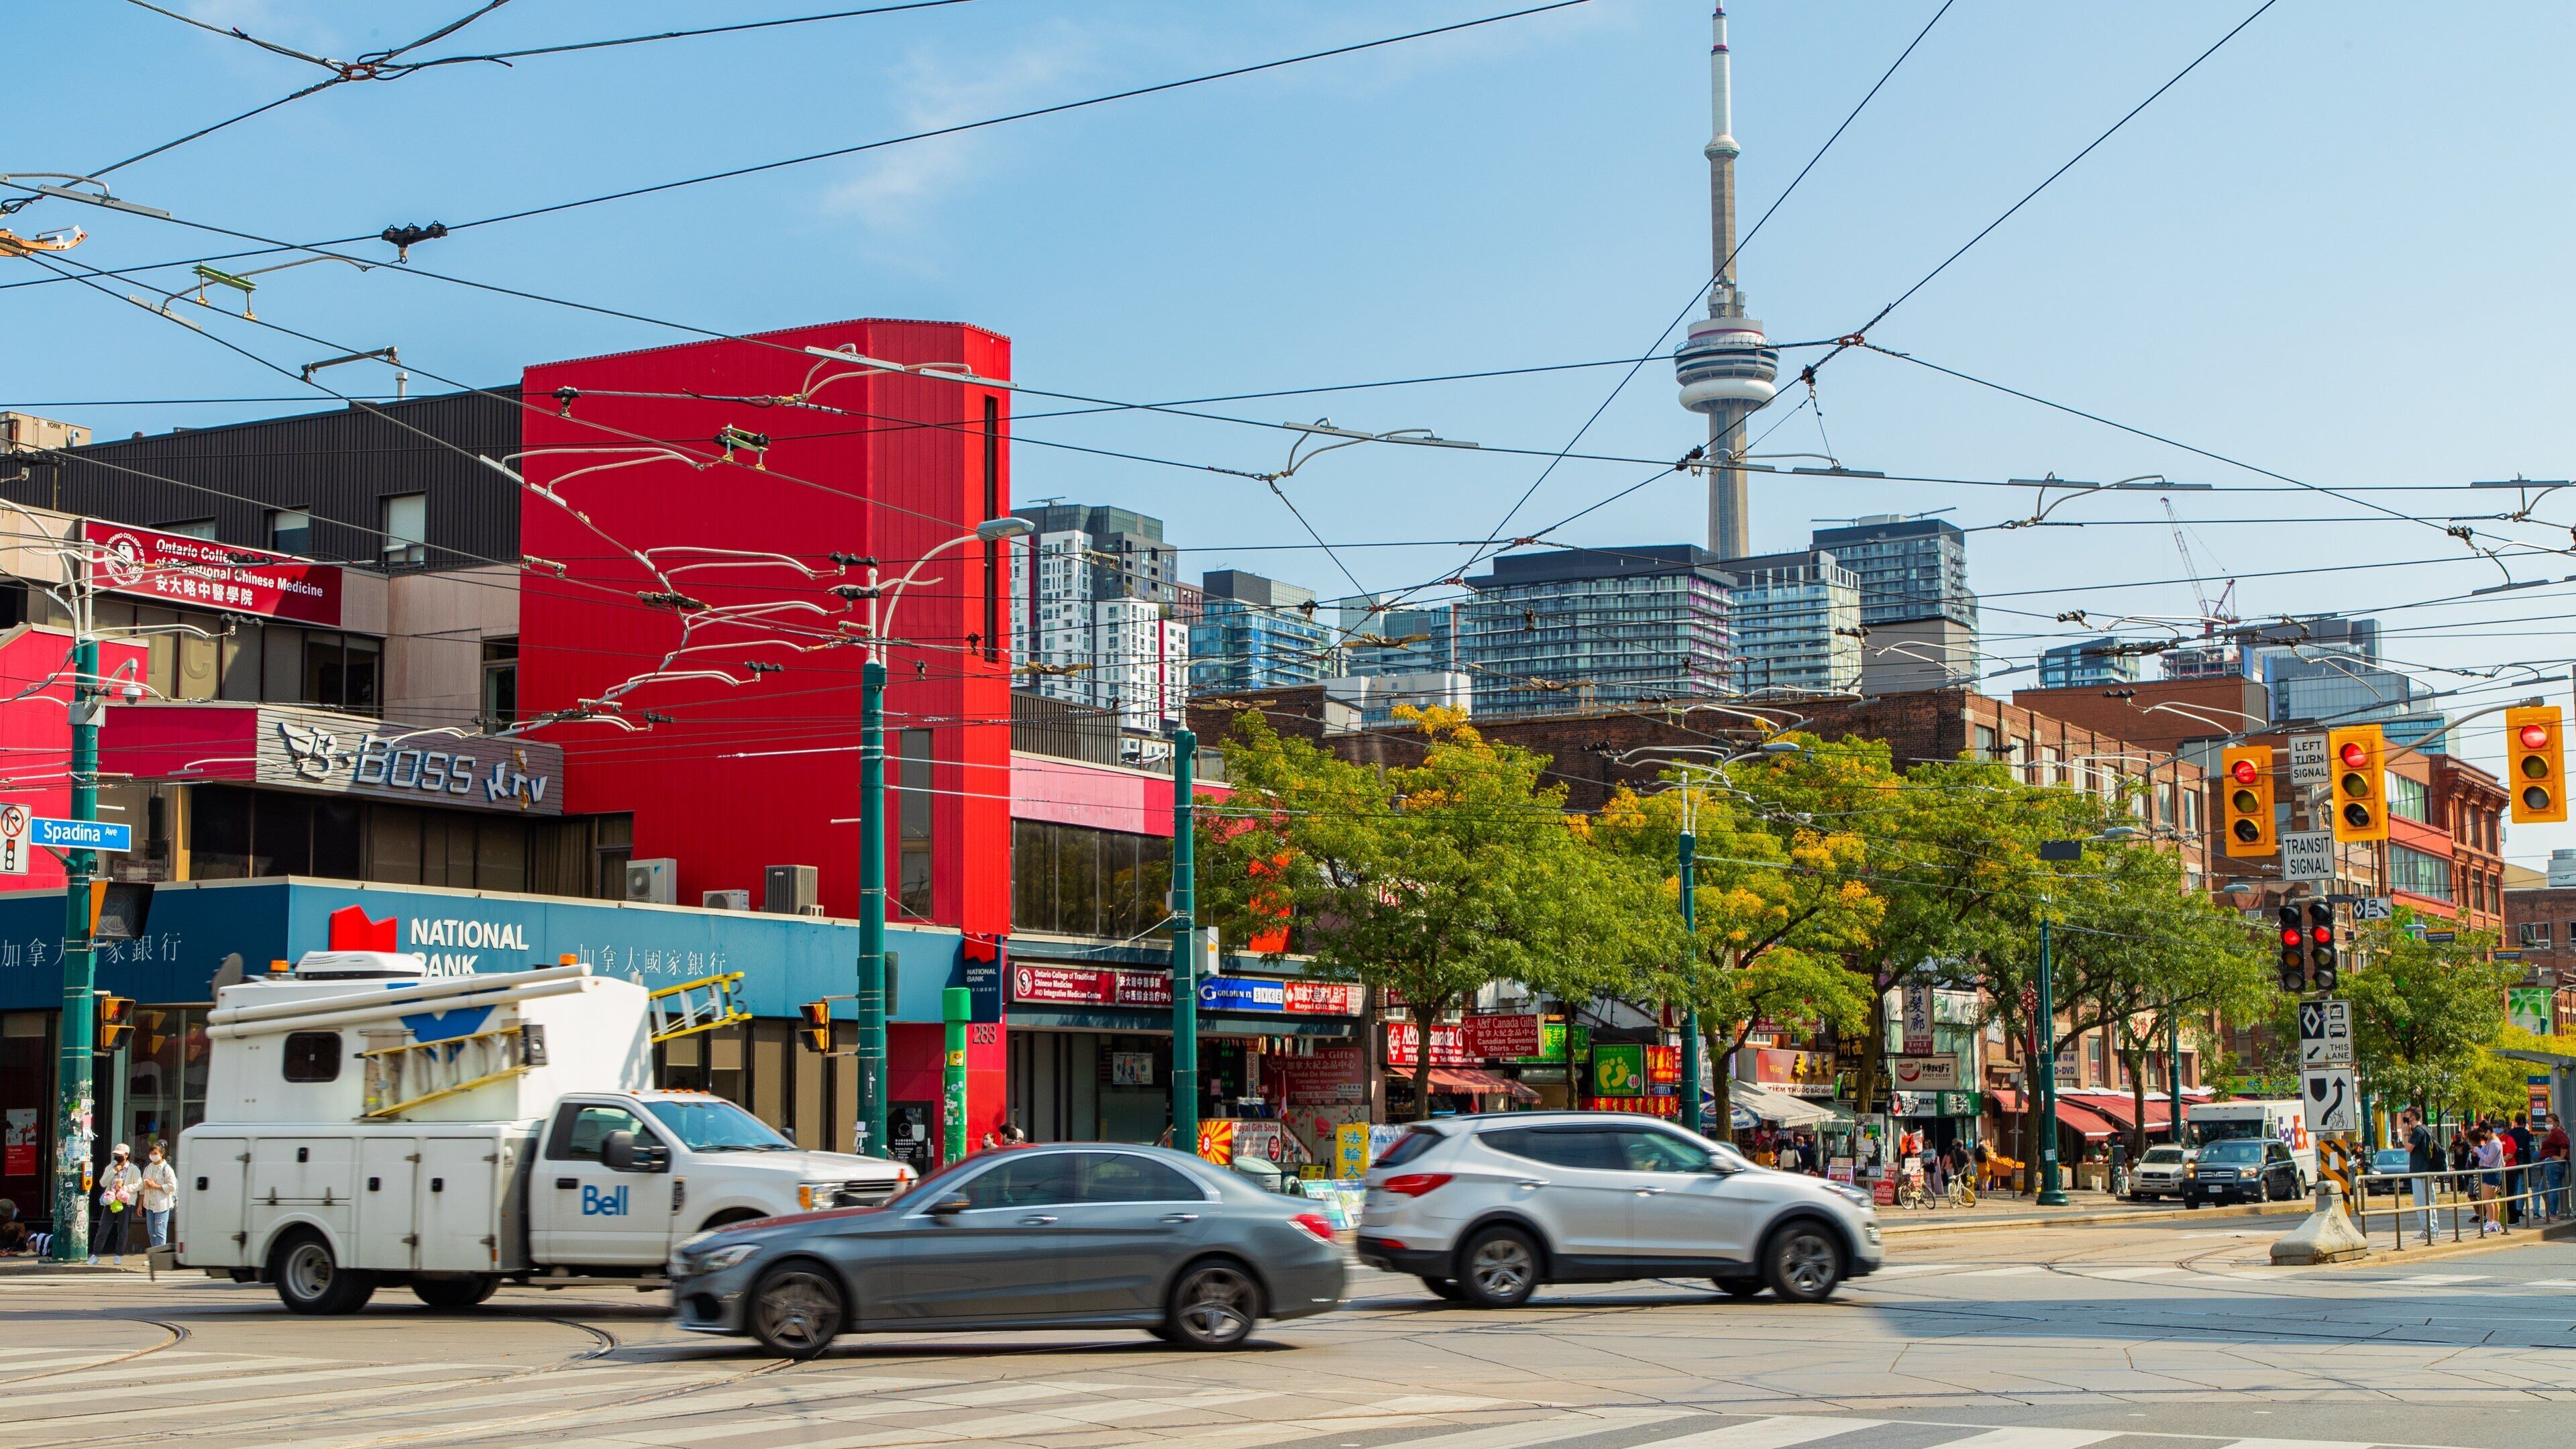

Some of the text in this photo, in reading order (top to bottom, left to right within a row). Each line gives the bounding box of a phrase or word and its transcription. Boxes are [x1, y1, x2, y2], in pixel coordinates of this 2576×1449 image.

[156, 539, 235, 564] Ontario Colle
[155, 574, 253, 606] 安大略中醫學院
[235, 568, 274, 588] Chinese
[277, 577, 323, 597] Medicine
[2295, 741, 2322, 752] LEFT
[2294, 754, 2324, 765] TURN
[2294, 767, 2327, 779] SIGNAL
[483, 761, 548, 804] KTV
[44, 822, 117, 843] Spadina Ave
[2286, 837, 2330, 855] TRANSIT
[2290, 857, 2329, 875] SIGNAL
[411, 918, 530, 951] NATIONAL
[0, 932, 182, 967] 加拿大家銀行
[578, 943, 726, 977] 加拿大國家銀行
[1034, 969, 1051, 979] Ontario
[1052, 971, 1069, 981] College
[1074, 973, 1097, 981] Traditional
[1034, 979, 1073, 989] Chinese Medicine
[1043, 989, 1067, 999] Integrative
[1067, 990, 1087, 999] Medicine
[1087, 991, 1102, 1000] Centre
[1295, 1003, 1314, 1011] Royal
[1328, 1004, 1345, 1012] Shop
[1477, 1016, 1538, 1029] A&F Canada Gifts
[972, 1024, 998, 1044] 283
[1430, 1027, 1454, 1046] anada
[1328, 1051, 1355, 1059] Gifts
[2326, 1052, 2349, 1060] LANE
[1769, 1065, 1783, 1074] Wing
[1654, 1085, 1670, 1094] CITIZEN
[1234, 1123, 1279, 1134] Royal Gift Shop
[2277, 1115, 2309, 1152] FedEx
[1343, 1131, 1362, 1179] 法輪大
[582, 1185, 629, 1216] Bell
